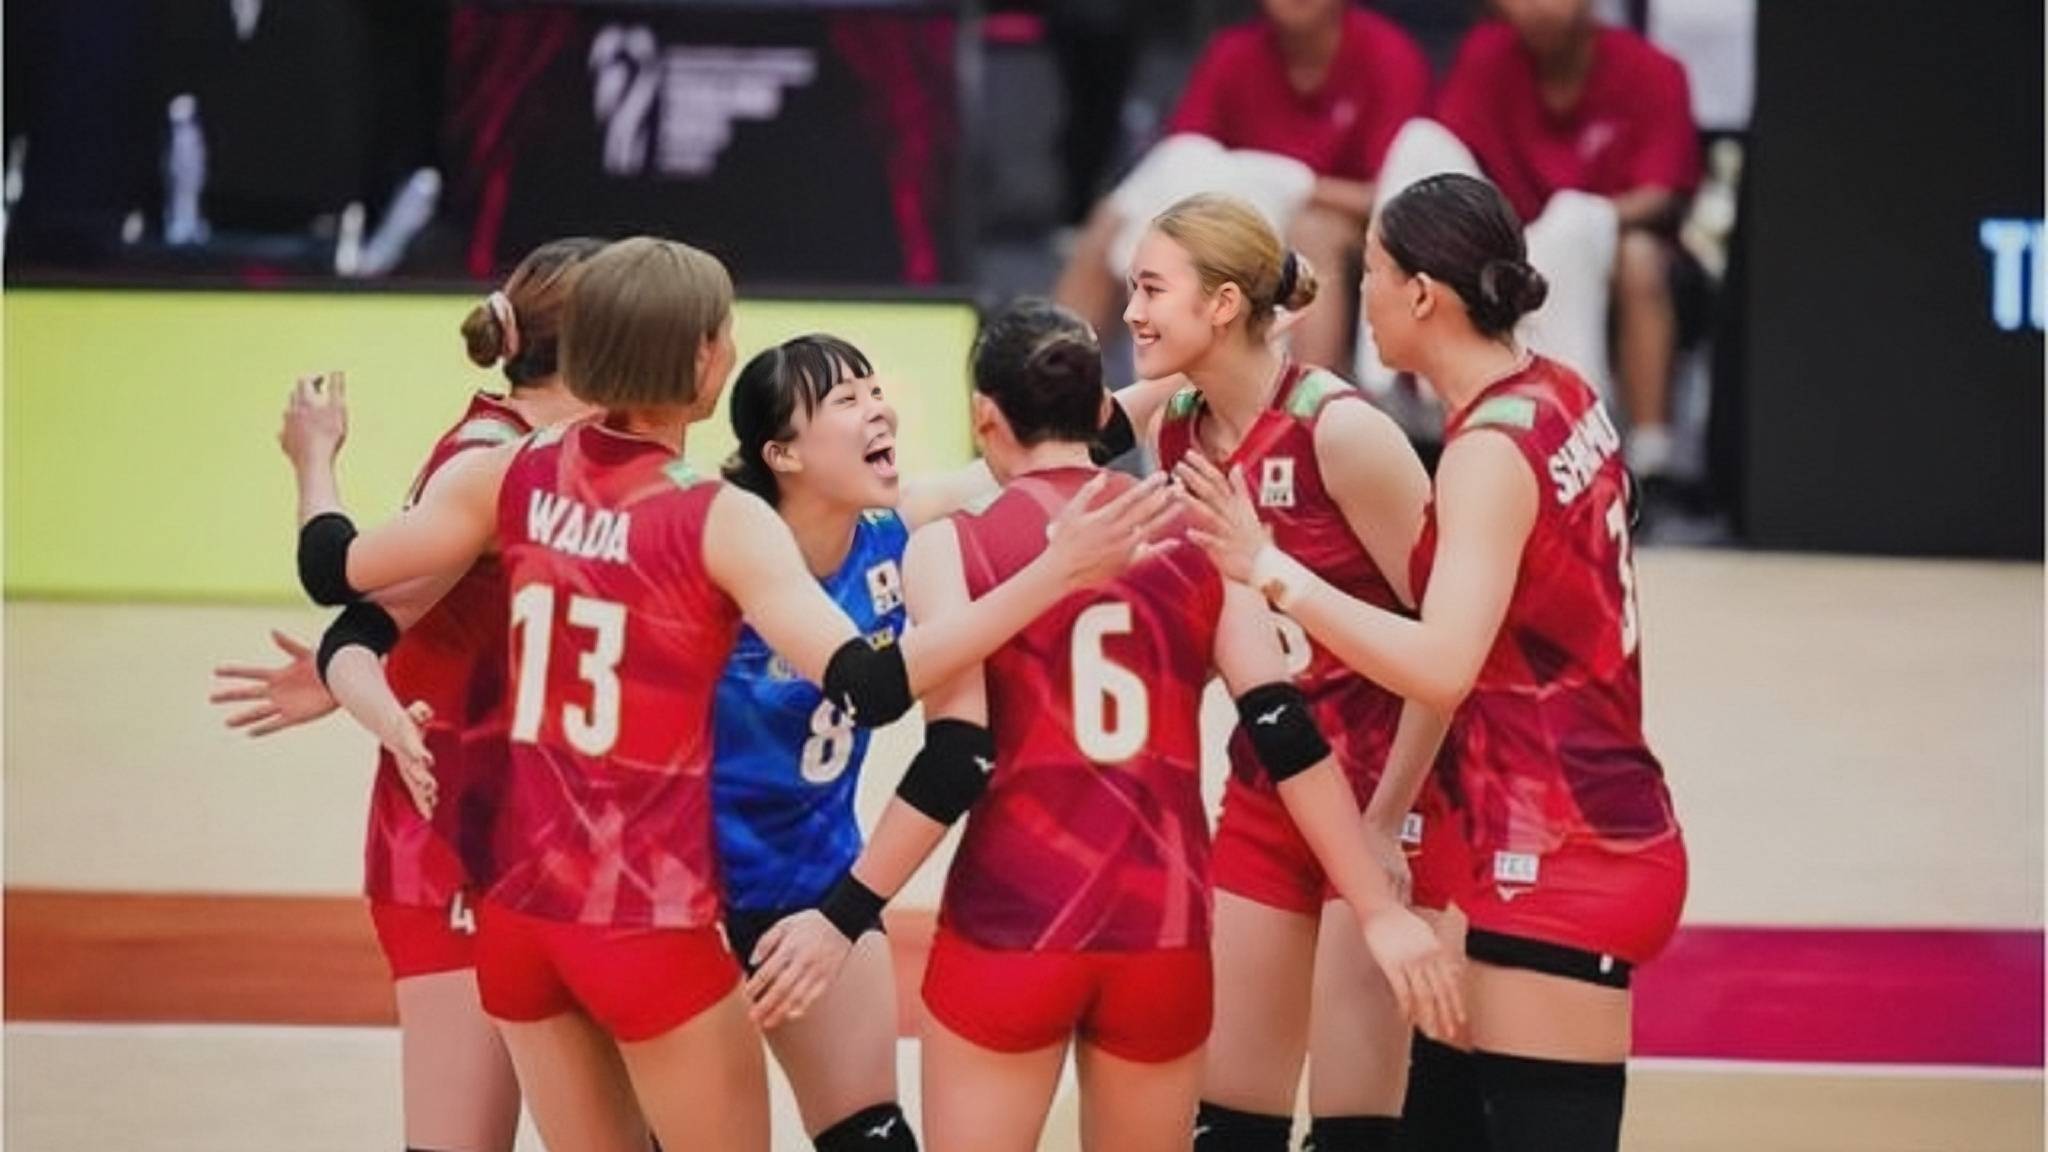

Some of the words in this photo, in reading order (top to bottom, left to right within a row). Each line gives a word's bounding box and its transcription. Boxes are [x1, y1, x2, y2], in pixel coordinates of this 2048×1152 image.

[527, 488, 632, 564] WADA
[510, 581, 628, 757] 13
[1070, 601, 1150, 765] 6
[801, 697, 858, 785] 8
[450, 890, 477, 935] 4
